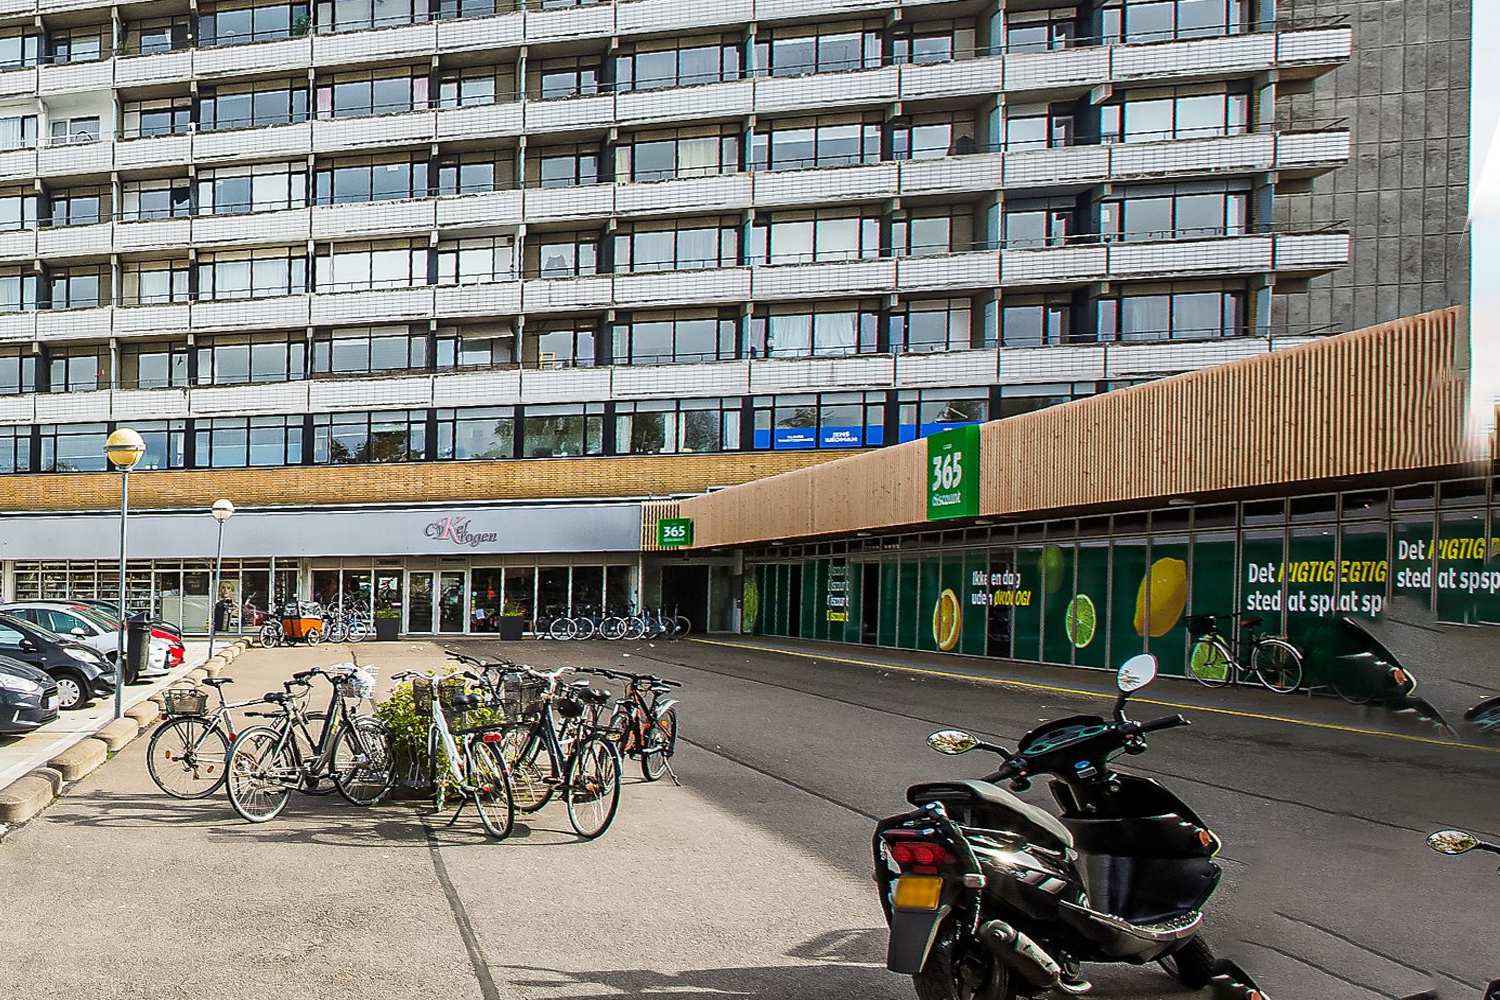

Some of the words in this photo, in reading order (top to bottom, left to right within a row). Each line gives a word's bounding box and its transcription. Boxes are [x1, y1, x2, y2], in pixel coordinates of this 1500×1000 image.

[932, 452, 962, 491] 365
[932, 489, 961, 506] discount
[663, 525, 685, 537] 365
[1398, 539, 1425, 560] Det
[991, 573, 1002, 586] en
[1248, 563, 1275, 582] Det
[1397, 567, 1431, 588] sted
[1438, 567, 1457, 588] at
[971, 590, 993, 605] uden
[1247, 590, 1282, 611] sted
[1288, 590, 1307, 612] at
